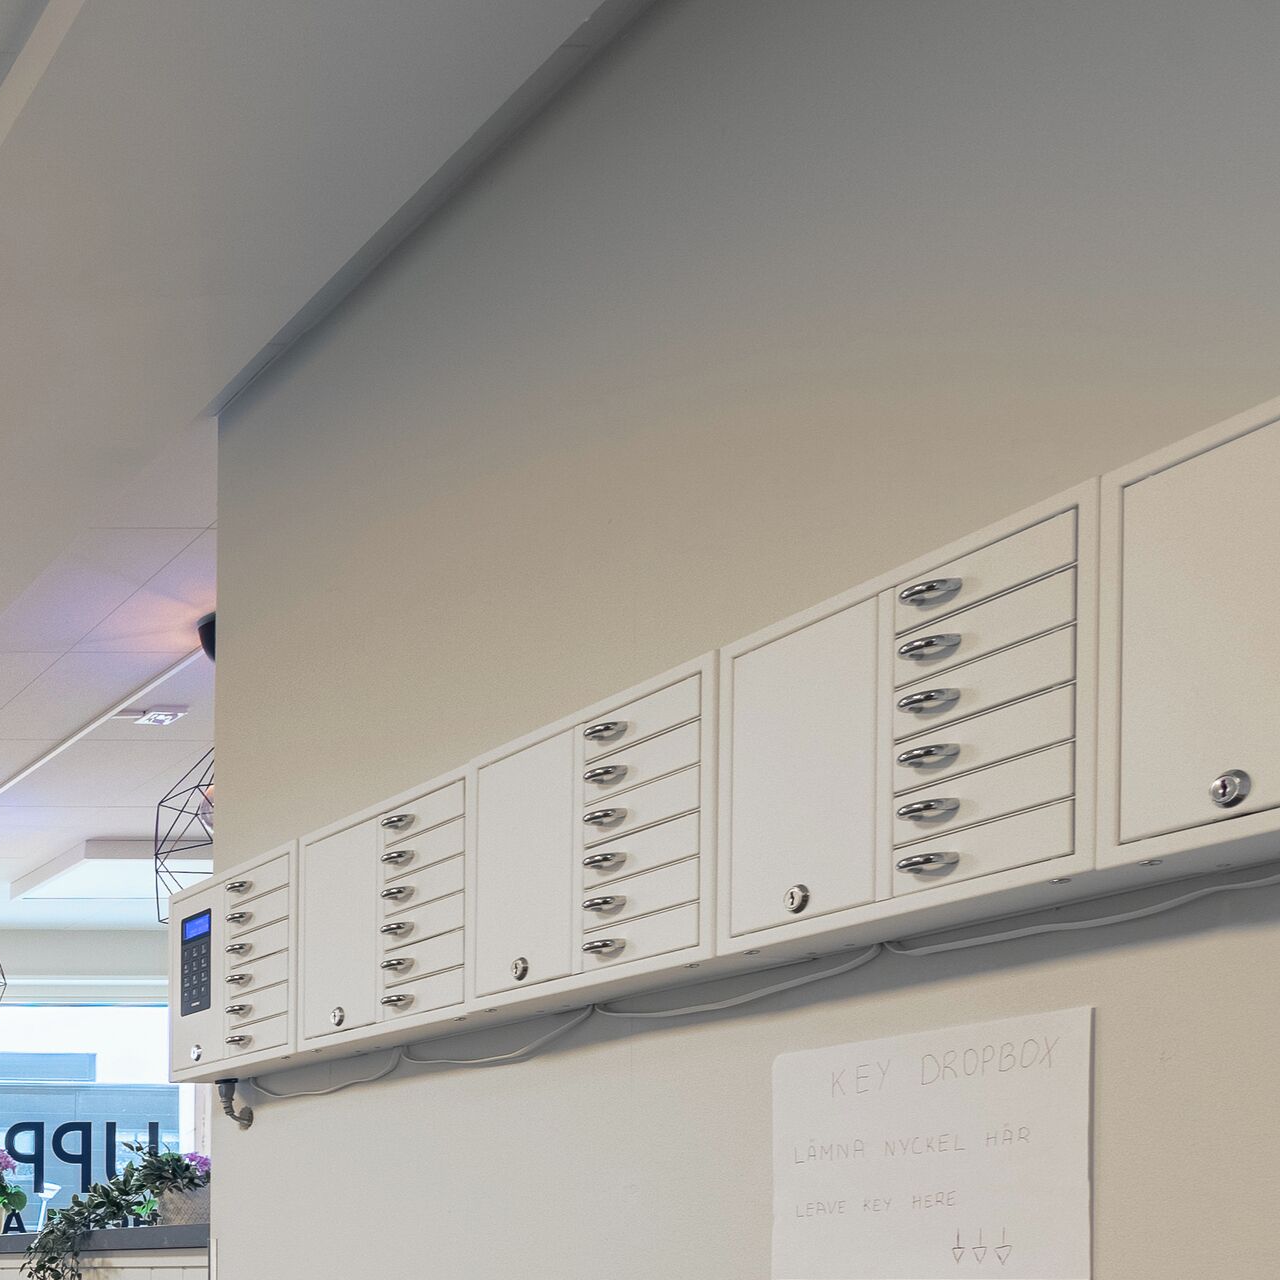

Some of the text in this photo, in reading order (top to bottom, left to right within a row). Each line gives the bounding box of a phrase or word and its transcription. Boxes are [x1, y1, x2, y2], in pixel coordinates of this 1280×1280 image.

[831, 1036, 1060, 1098] KEY DROPBOX
[794, 1138, 865, 1164] LÄMNA
[884, 1133, 966, 1158] NYCKEL
[796, 1190, 957, 1218] LEAVE KEY HERE
